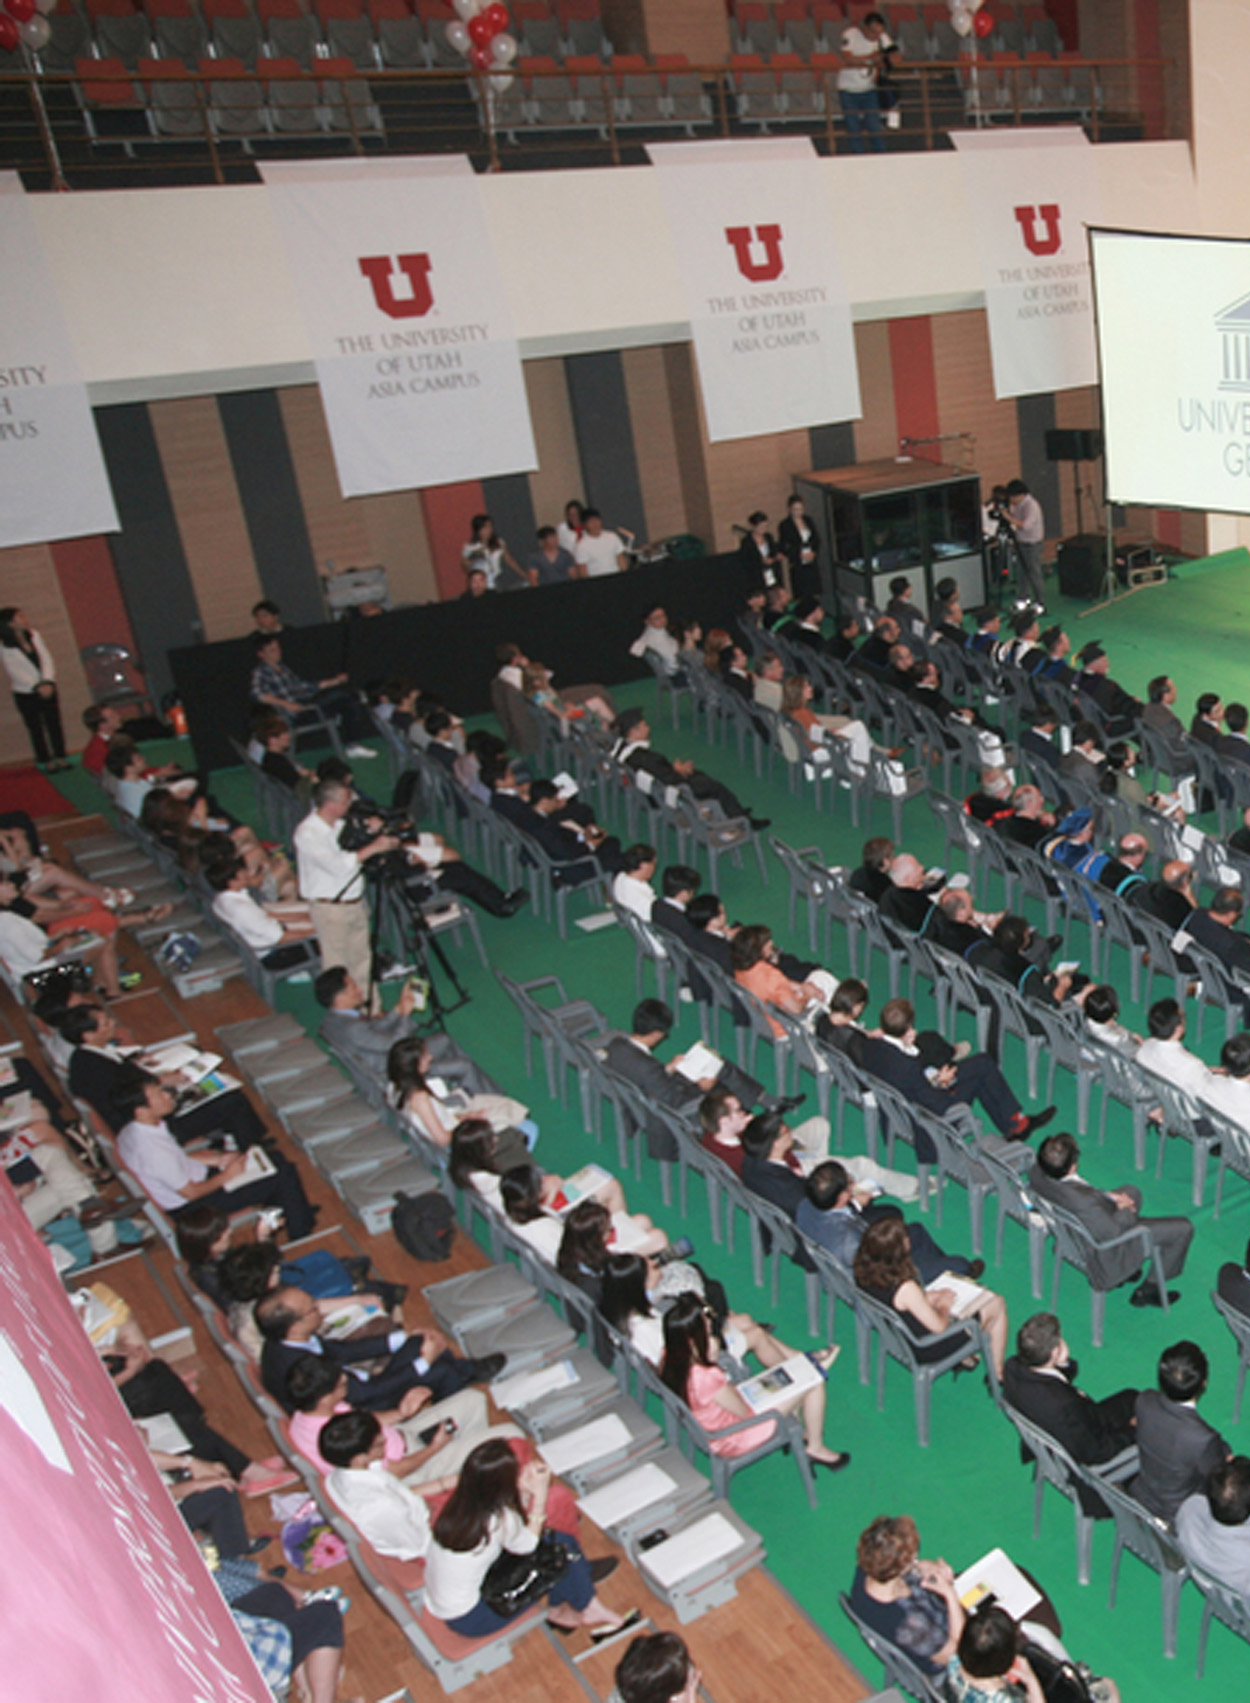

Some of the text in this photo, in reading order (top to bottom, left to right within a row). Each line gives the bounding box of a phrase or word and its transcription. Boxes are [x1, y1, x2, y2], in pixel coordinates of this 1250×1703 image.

[1014, 204, 1061, 256] U
[725, 224, 784, 283] U
[357, 252, 435, 320] U
[707, 286, 827, 314] THE UNIVERSITY
[738, 311, 806, 332] OF UTAH
[335, 323, 490, 354] THE UNIVERSITY
[763, 329, 820, 350] CAMPUS
[375, 350, 463, 376] OF UTAH
[367, 370, 482, 400] ASIA CAMPUS
